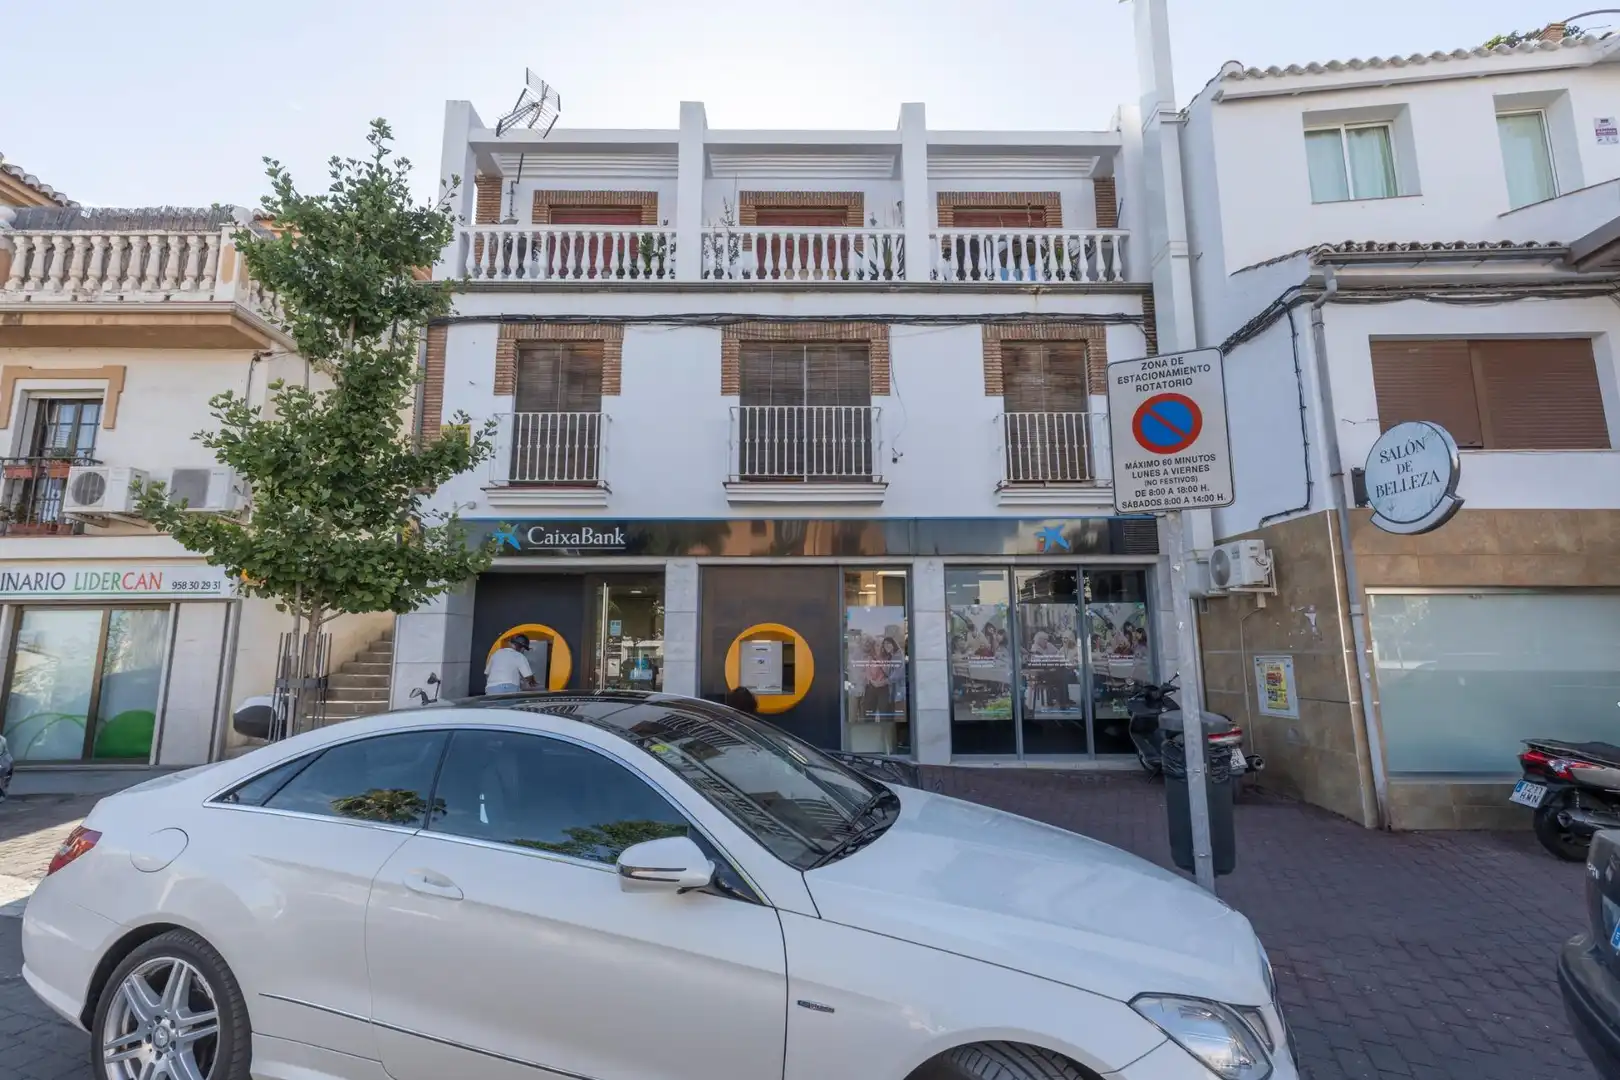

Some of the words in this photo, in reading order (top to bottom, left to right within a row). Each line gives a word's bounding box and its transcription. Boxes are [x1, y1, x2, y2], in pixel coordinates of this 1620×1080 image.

[1141, 359, 1168, 370] ZONA
[1171, 357, 1184, 366] DE
[1117, 364, 1211, 384] ESTACIONAMIENTO
[1136, 377, 1193, 392] ROTATORIO
[1380, 438, 1425, 464] SALÓN
[1162, 458, 1172, 466] 60
[1175, 454, 1216, 464] MINUTOS
[1396, 460, 1413, 475] DE
[1132, 469, 1160, 478] LUNES
[1163, 468, 1169, 476] A
[1171, 464, 1210, 475] VIERNES
[1160, 476, 1198, 485] FESTIVOS)
[1376, 469, 1440, 498] BELLEZA
[1149, 488, 1165, 496] 8:00
[1177, 485, 1198, 493] 18:00
[1164, 497, 1180, 505] 8:00
[527, 526, 626, 545] CaixaBank
[0, 572, 66, 591] INARIO
[74, 572, 162, 591] LIDERCAN
[171, 580, 187, 590] 958
[188, 580, 200, 590] 30
[200, 580, 211, 590] 29
[212, 580, 221, 590] 31
